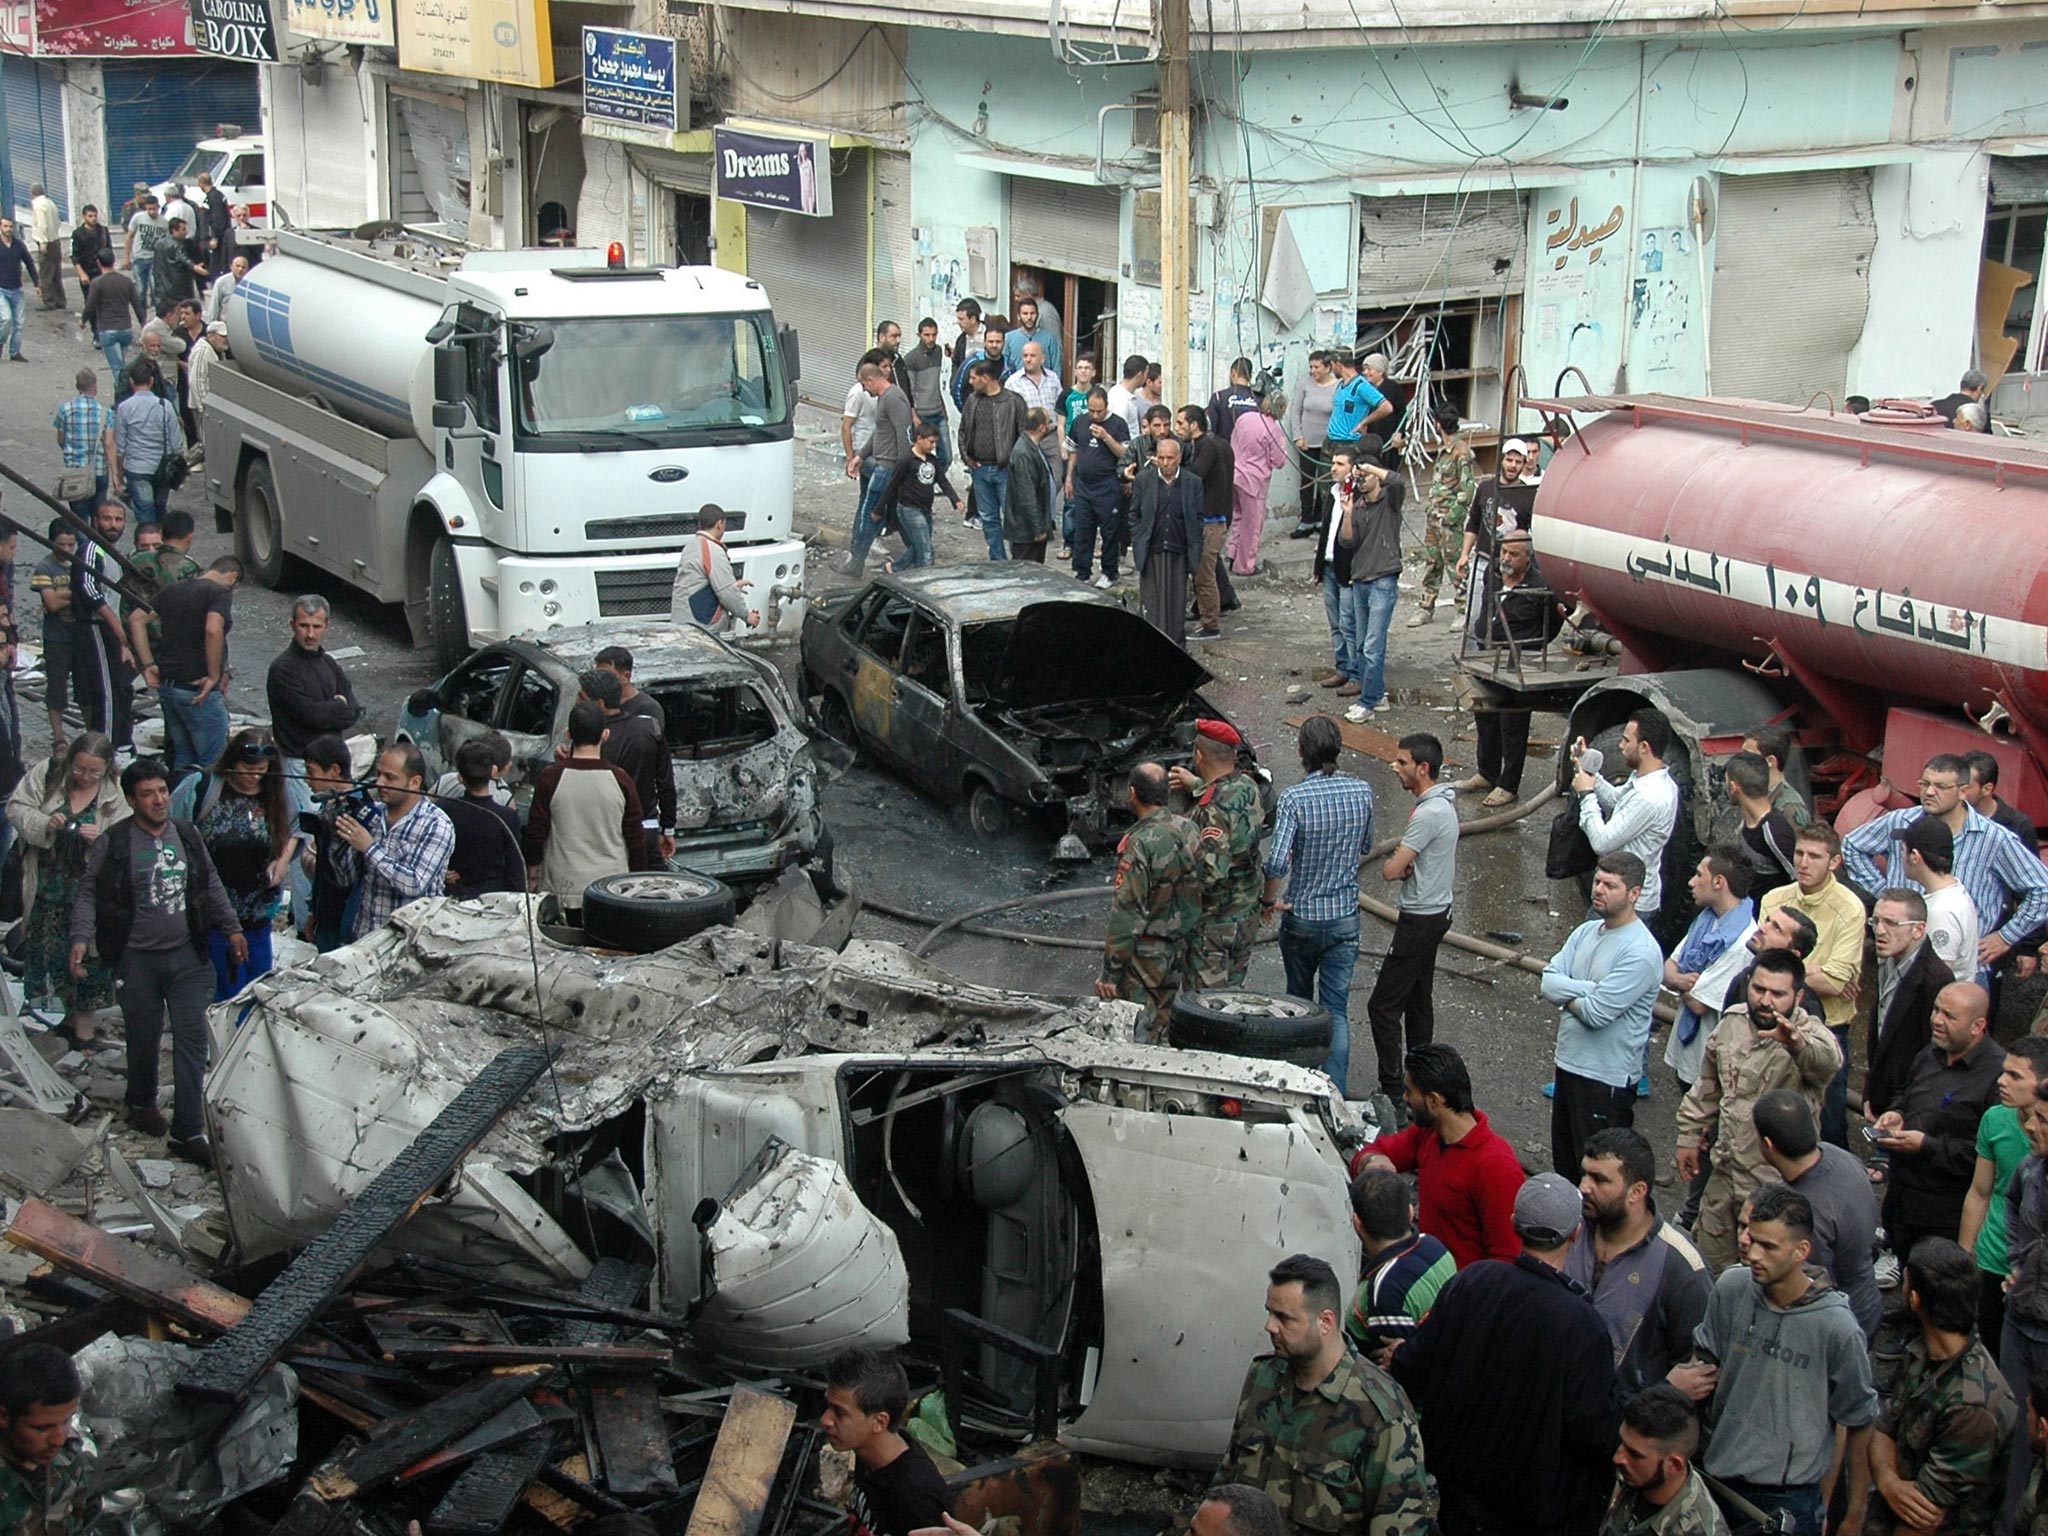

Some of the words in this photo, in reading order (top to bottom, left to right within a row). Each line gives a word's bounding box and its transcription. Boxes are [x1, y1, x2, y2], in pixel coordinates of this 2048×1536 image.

[202, 0, 267, 24] CAROLINA
[151, 36, 176, 50] مكياج
[206, 19, 272, 60] BOIX
[620, 60, 641, 82] محمود
[642, 60, 666, 90] يوسف
[723, 148, 791, 179] Dreams
[1547, 197, 1625, 270] صيدلية
[1625, 534, 1732, 595] المدني
[1765, 562, 1827, 626] ١٠٩
[1851, 586, 1987, 654] الدفاع
